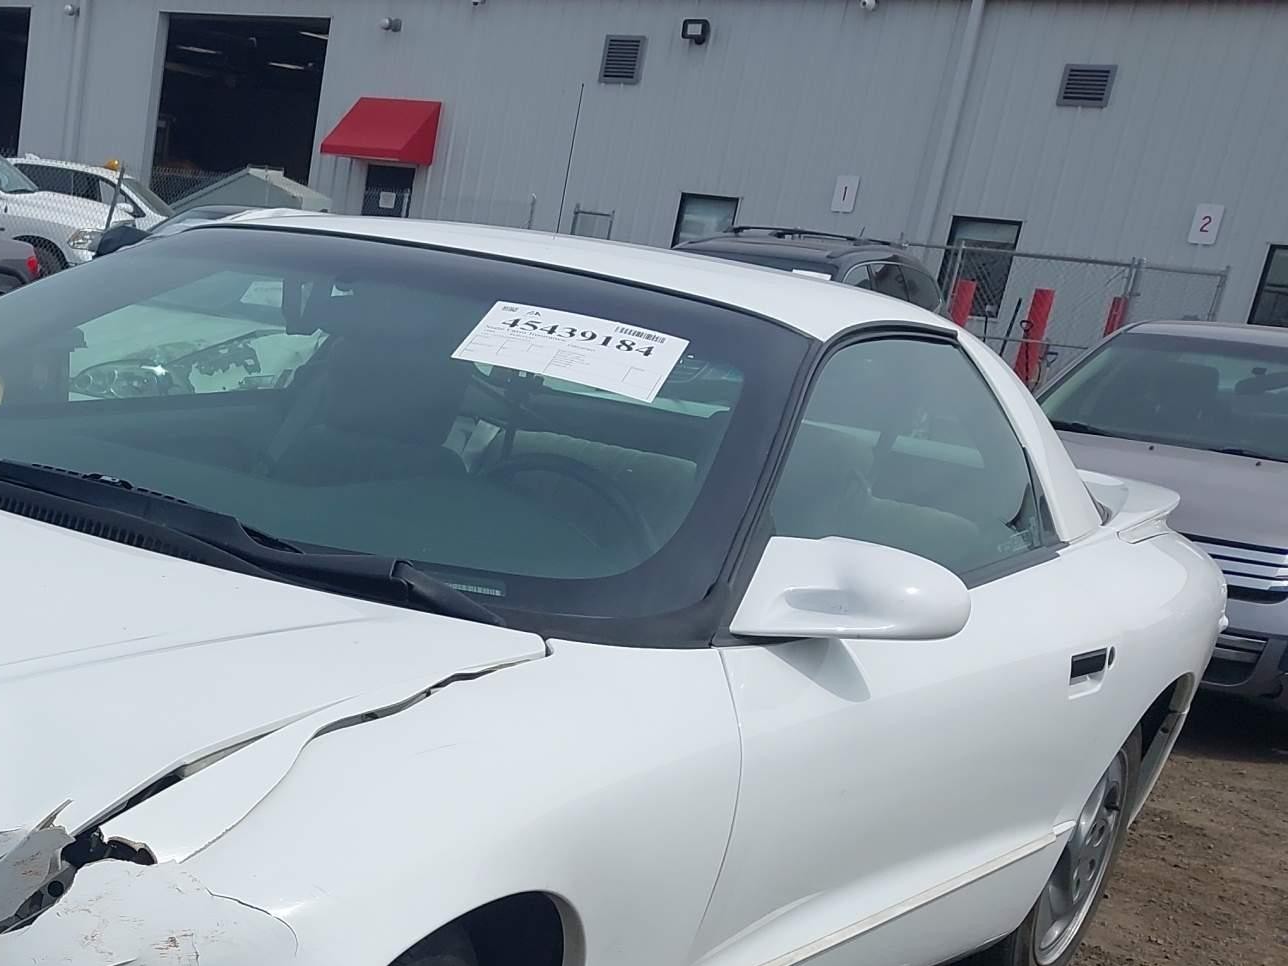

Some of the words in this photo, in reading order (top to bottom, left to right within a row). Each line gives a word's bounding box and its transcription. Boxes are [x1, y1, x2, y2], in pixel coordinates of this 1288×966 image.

[842, 186, 848, 201] 1
[1199, 215, 1212, 232] 2
[501, 317, 654, 358] 45439184
